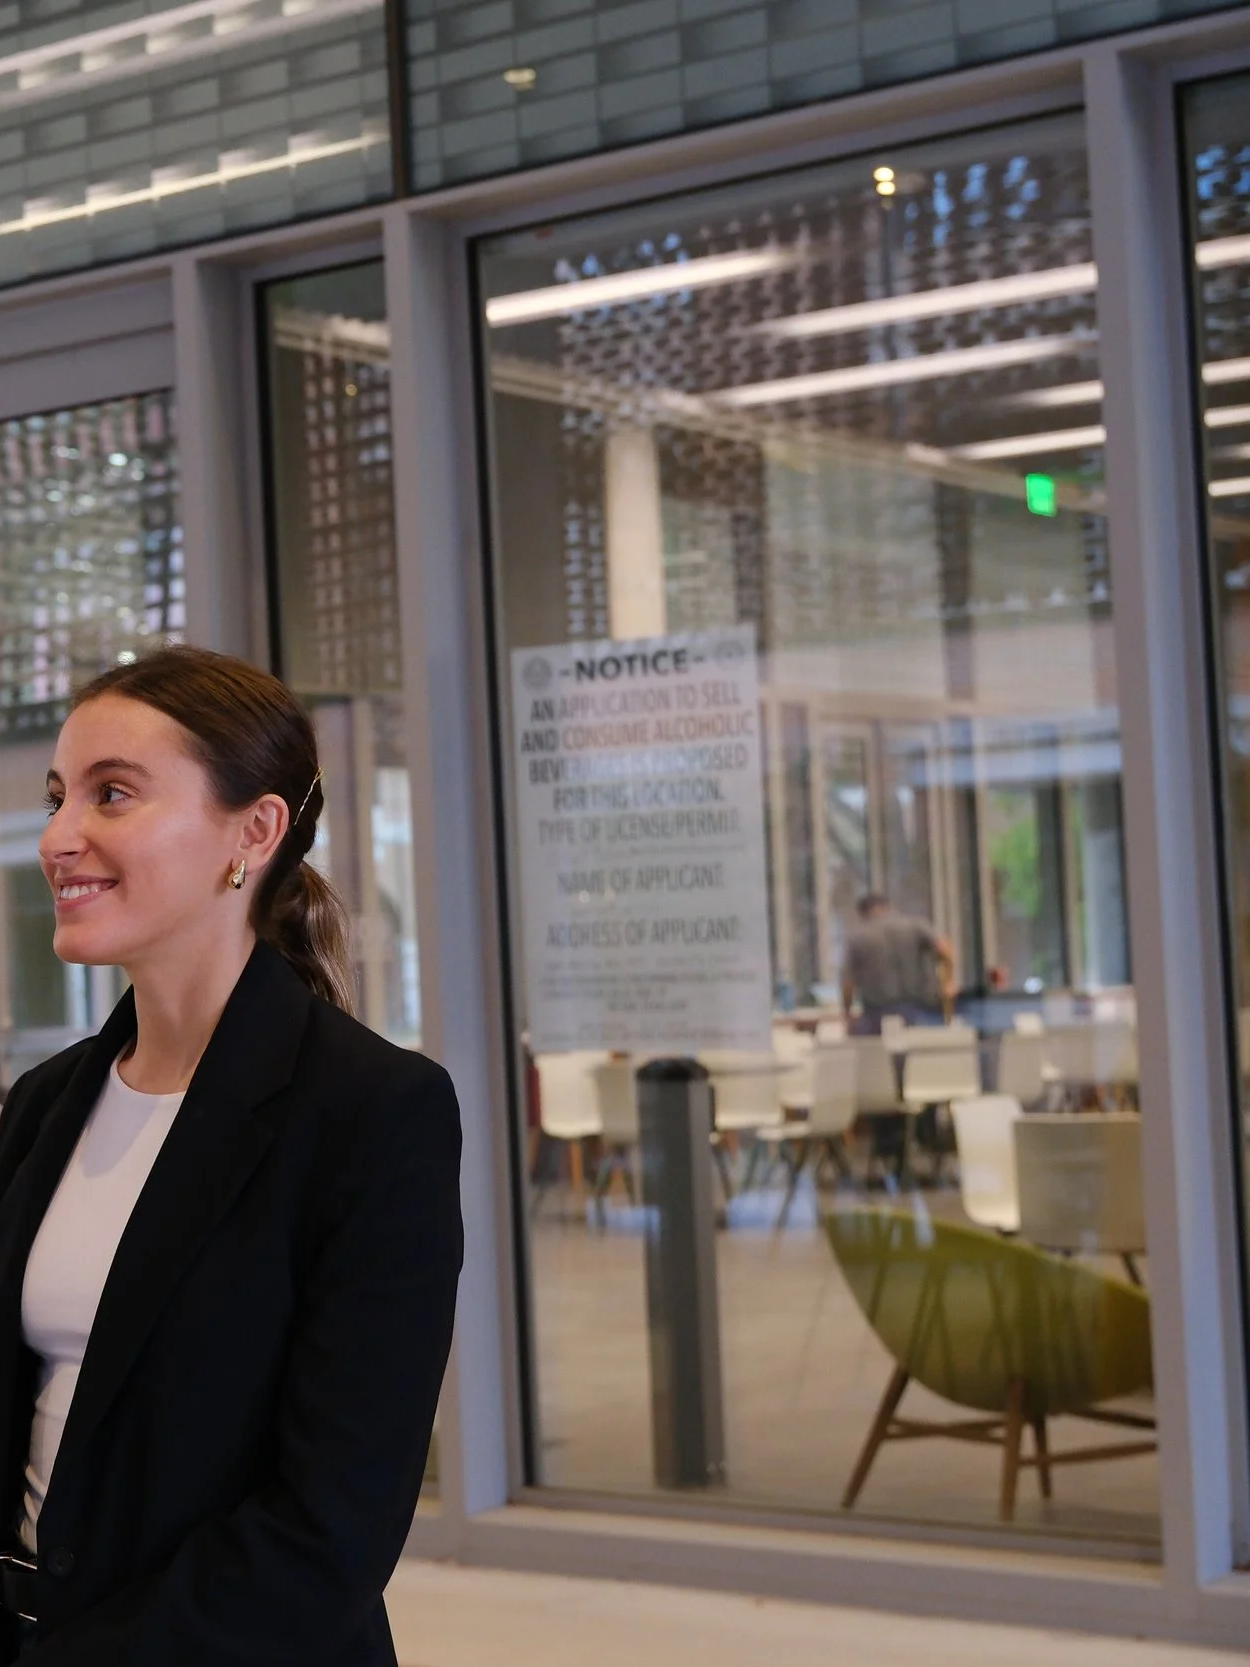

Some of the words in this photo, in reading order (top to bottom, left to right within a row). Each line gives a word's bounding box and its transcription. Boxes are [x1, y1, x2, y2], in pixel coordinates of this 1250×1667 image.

[530, 698, 555, 722] AN
[558, 687, 670, 719] APPLICATION
[675, 684, 698, 709] TO
[701, 680, 741, 706] SELL
[521, 728, 559, 753] AND
[562, 720, 649, 750] CONSUME
[654, 709, 755, 742] ALCOHOLIC
[553, 785, 587, 813] FOR
[538, 816, 575, 845] TYPE
[580, 815, 602, 844] OF
[556, 867, 605, 897] NAME
[610, 865, 633, 893] OF
[625, 917, 648, 947] OF
